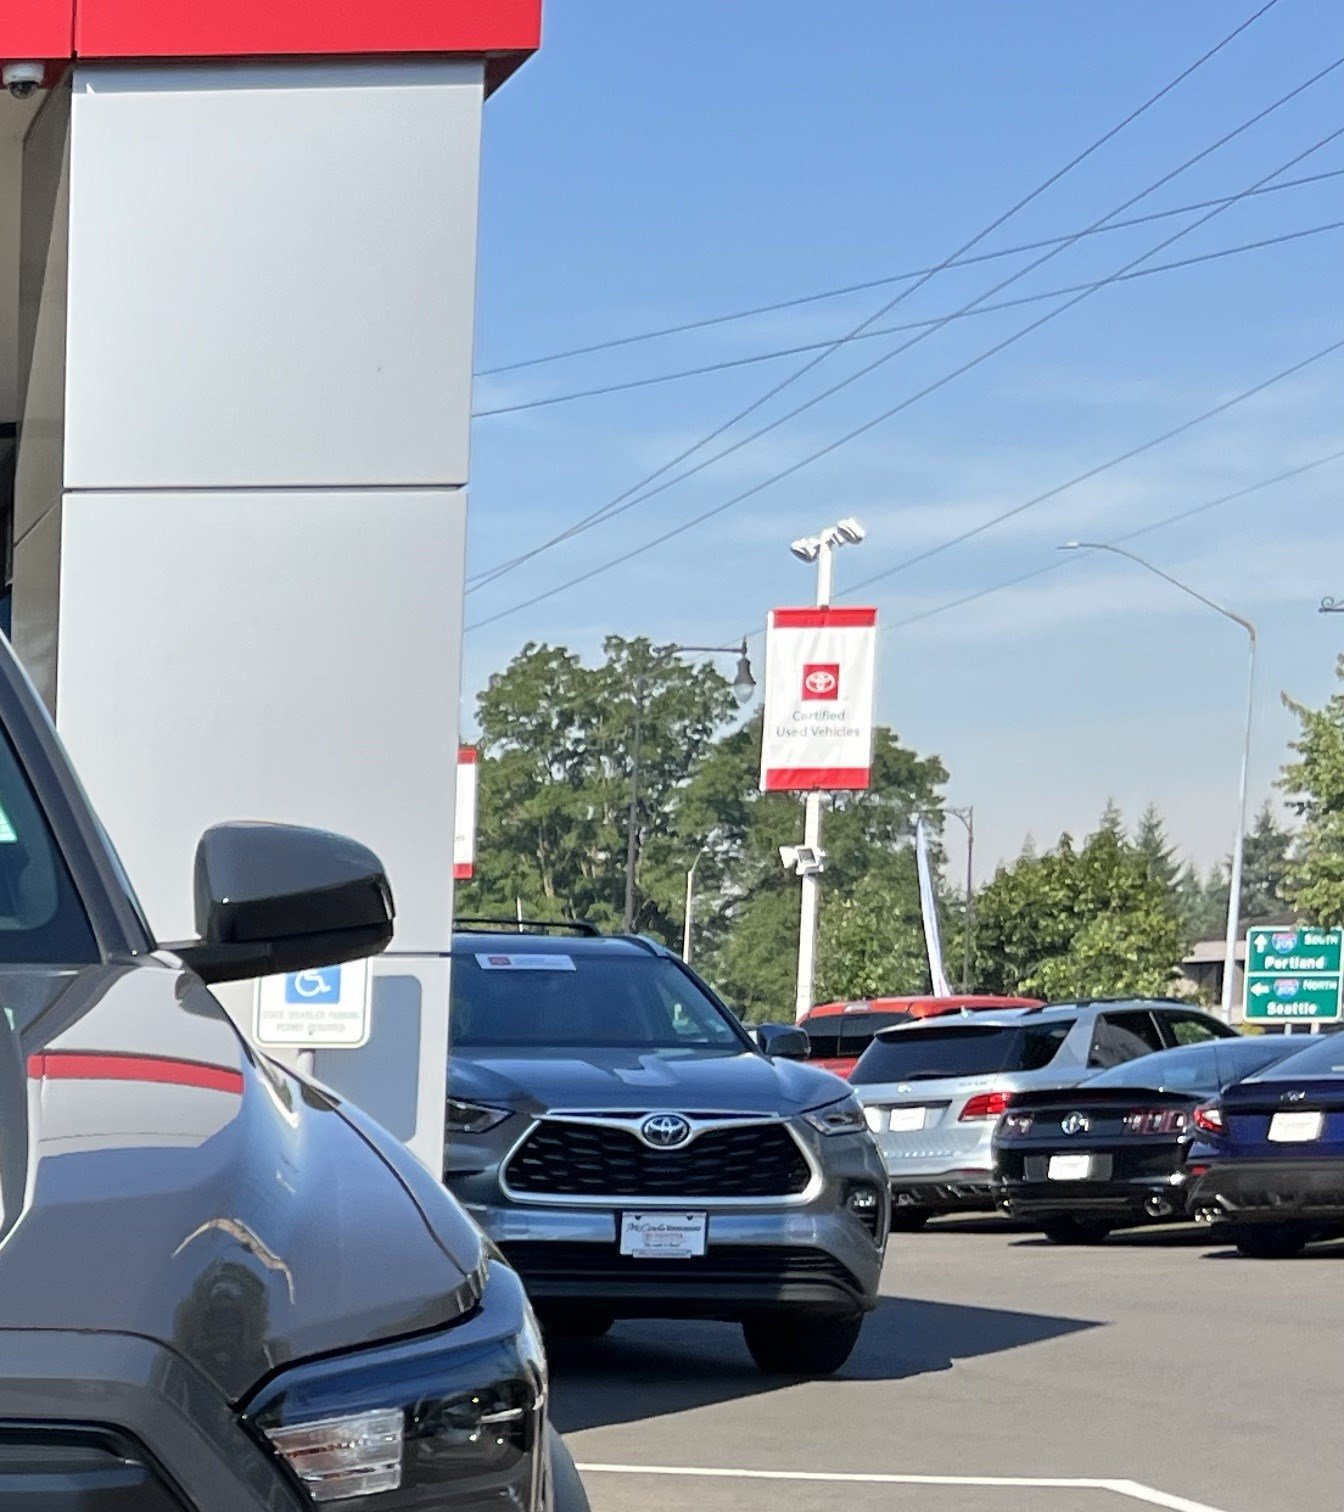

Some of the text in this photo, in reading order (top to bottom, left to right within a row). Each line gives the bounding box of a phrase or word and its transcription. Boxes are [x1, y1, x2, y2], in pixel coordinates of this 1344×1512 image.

[792, 709, 846, 722] Certified
[776, 726, 861, 738] Used Vehicles
[1264, 955, 1326, 970] Portland
[1266, 1001, 1318, 1015] Seattle
